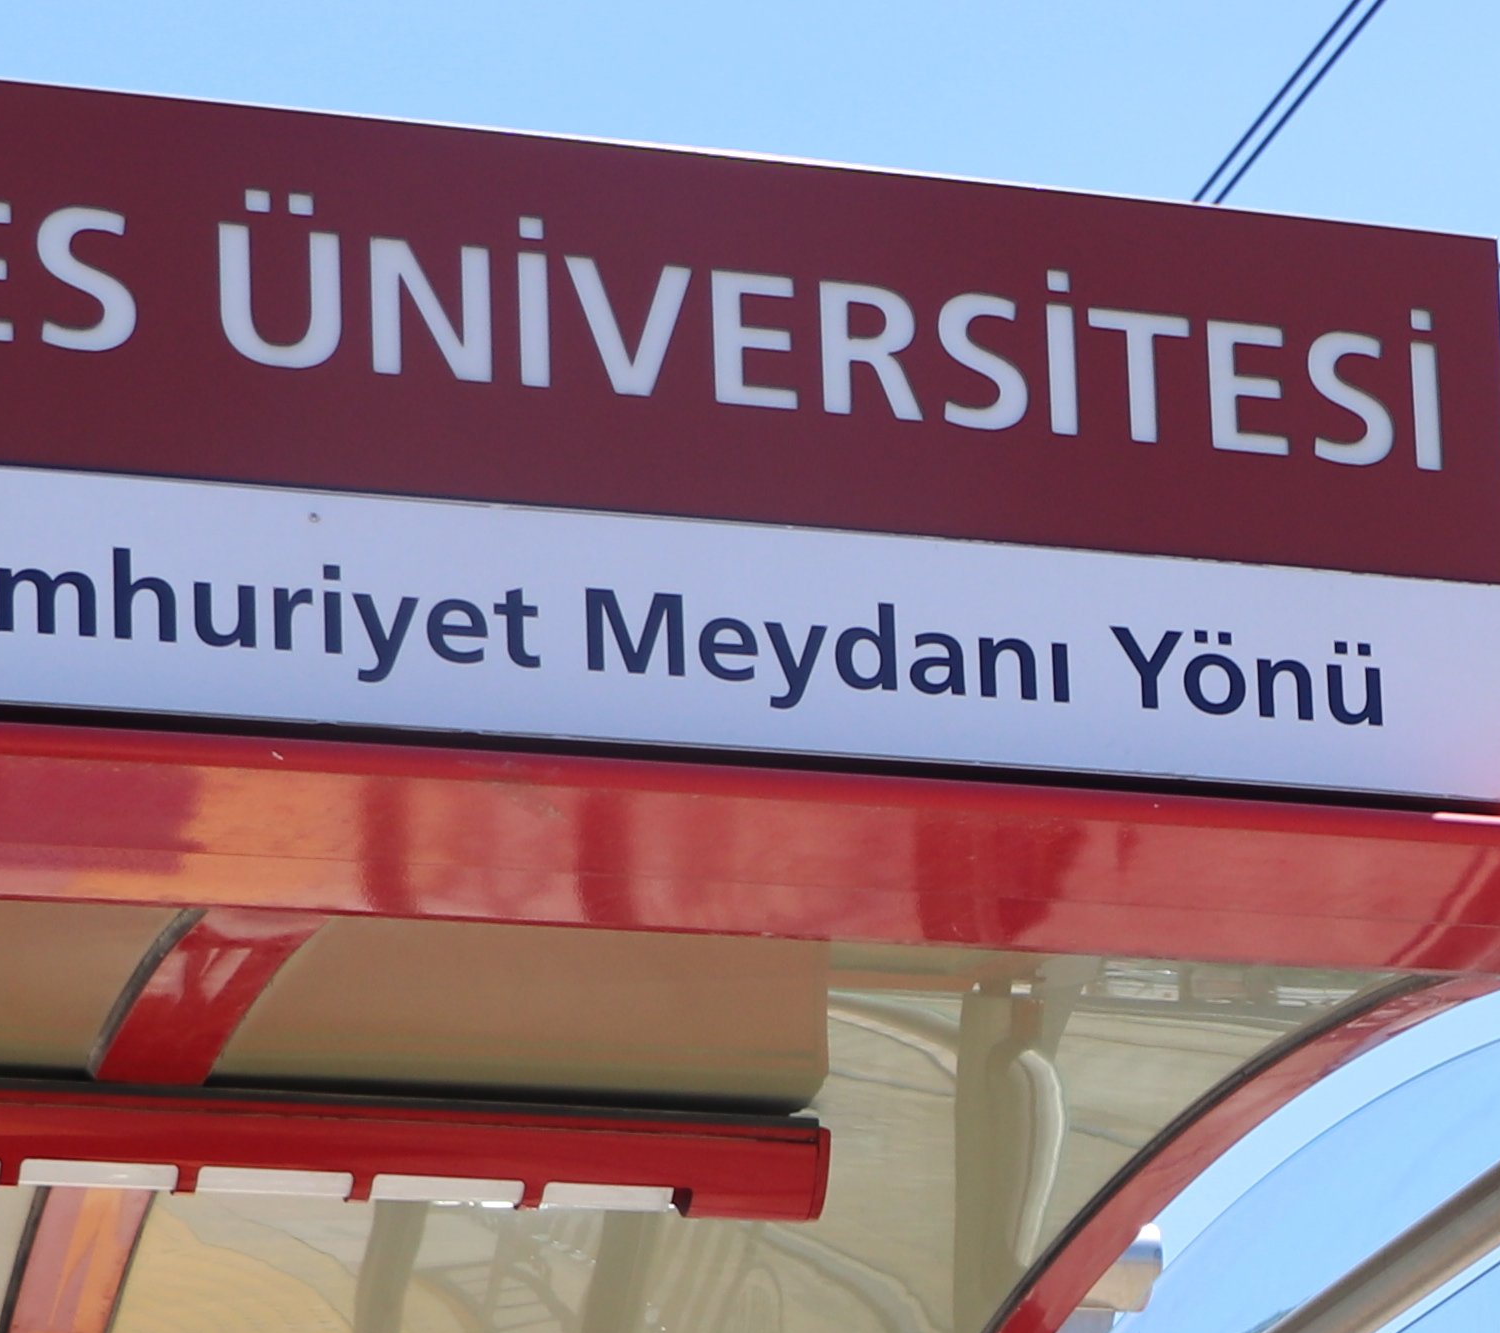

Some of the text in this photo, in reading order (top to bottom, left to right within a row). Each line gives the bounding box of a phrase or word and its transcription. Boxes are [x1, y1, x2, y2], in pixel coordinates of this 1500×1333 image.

[217, 188, 1442, 472] ÜNİVERSİTESİ
[585, 587, 1071, 711] Meydanı
[1109, 626, 1384, 728] Yönü
